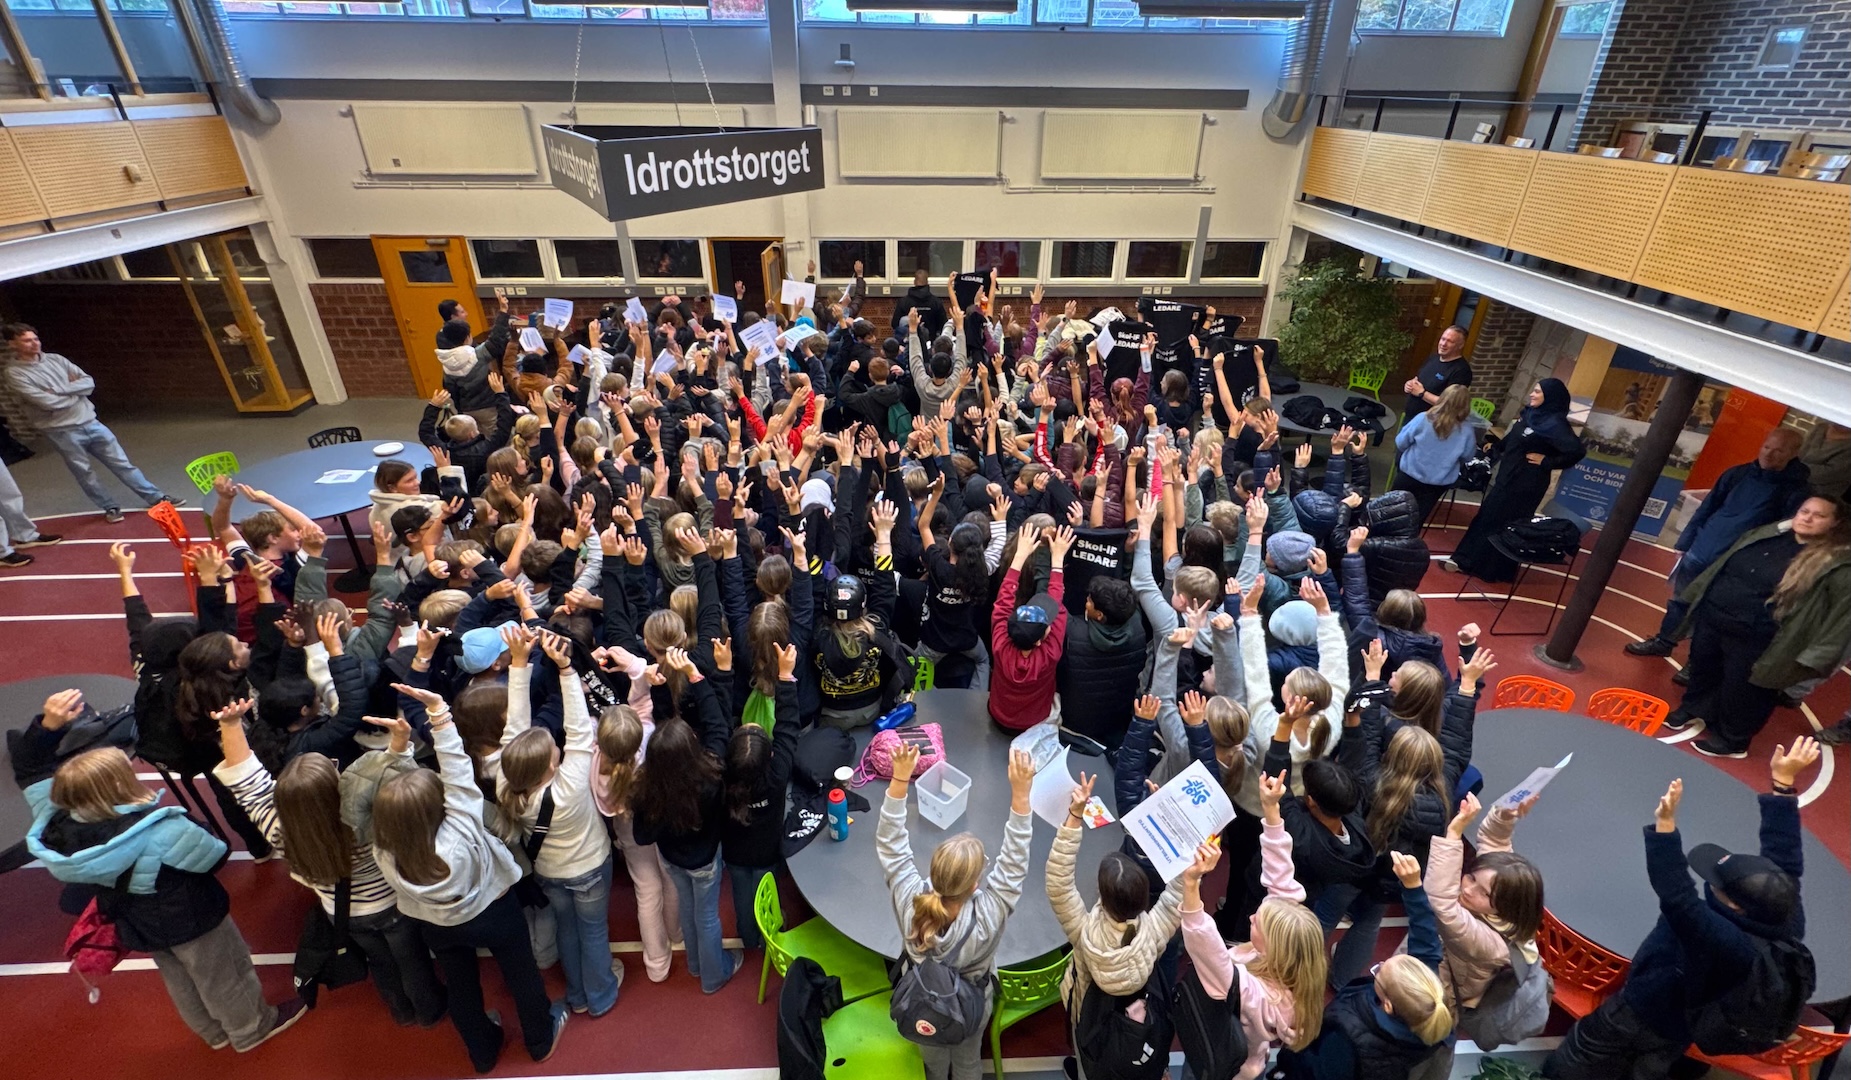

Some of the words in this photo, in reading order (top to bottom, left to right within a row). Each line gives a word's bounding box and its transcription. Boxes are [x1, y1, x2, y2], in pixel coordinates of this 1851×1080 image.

[546, 136, 601, 199] Idrottstorget
[624, 141, 811, 196] Idrottstorget
[960, 275, 984, 284] LEDARE
[1117, 331, 1140, 340] Skol-IF
[1209, 325, 1226, 335] DARE
[1114, 340, 1140, 349] LEDARE
[1574, 463, 1591, 473] VILL
[1592, 468, 1606, 476] DU
[1608, 471, 1627, 480] VAR
[1583, 474, 1604, 484] OCH
[1077, 539, 1118, 556] Skol-IF
[1072, 549, 1118, 568] LEDARE
[936, 593, 964, 604] LEDA
